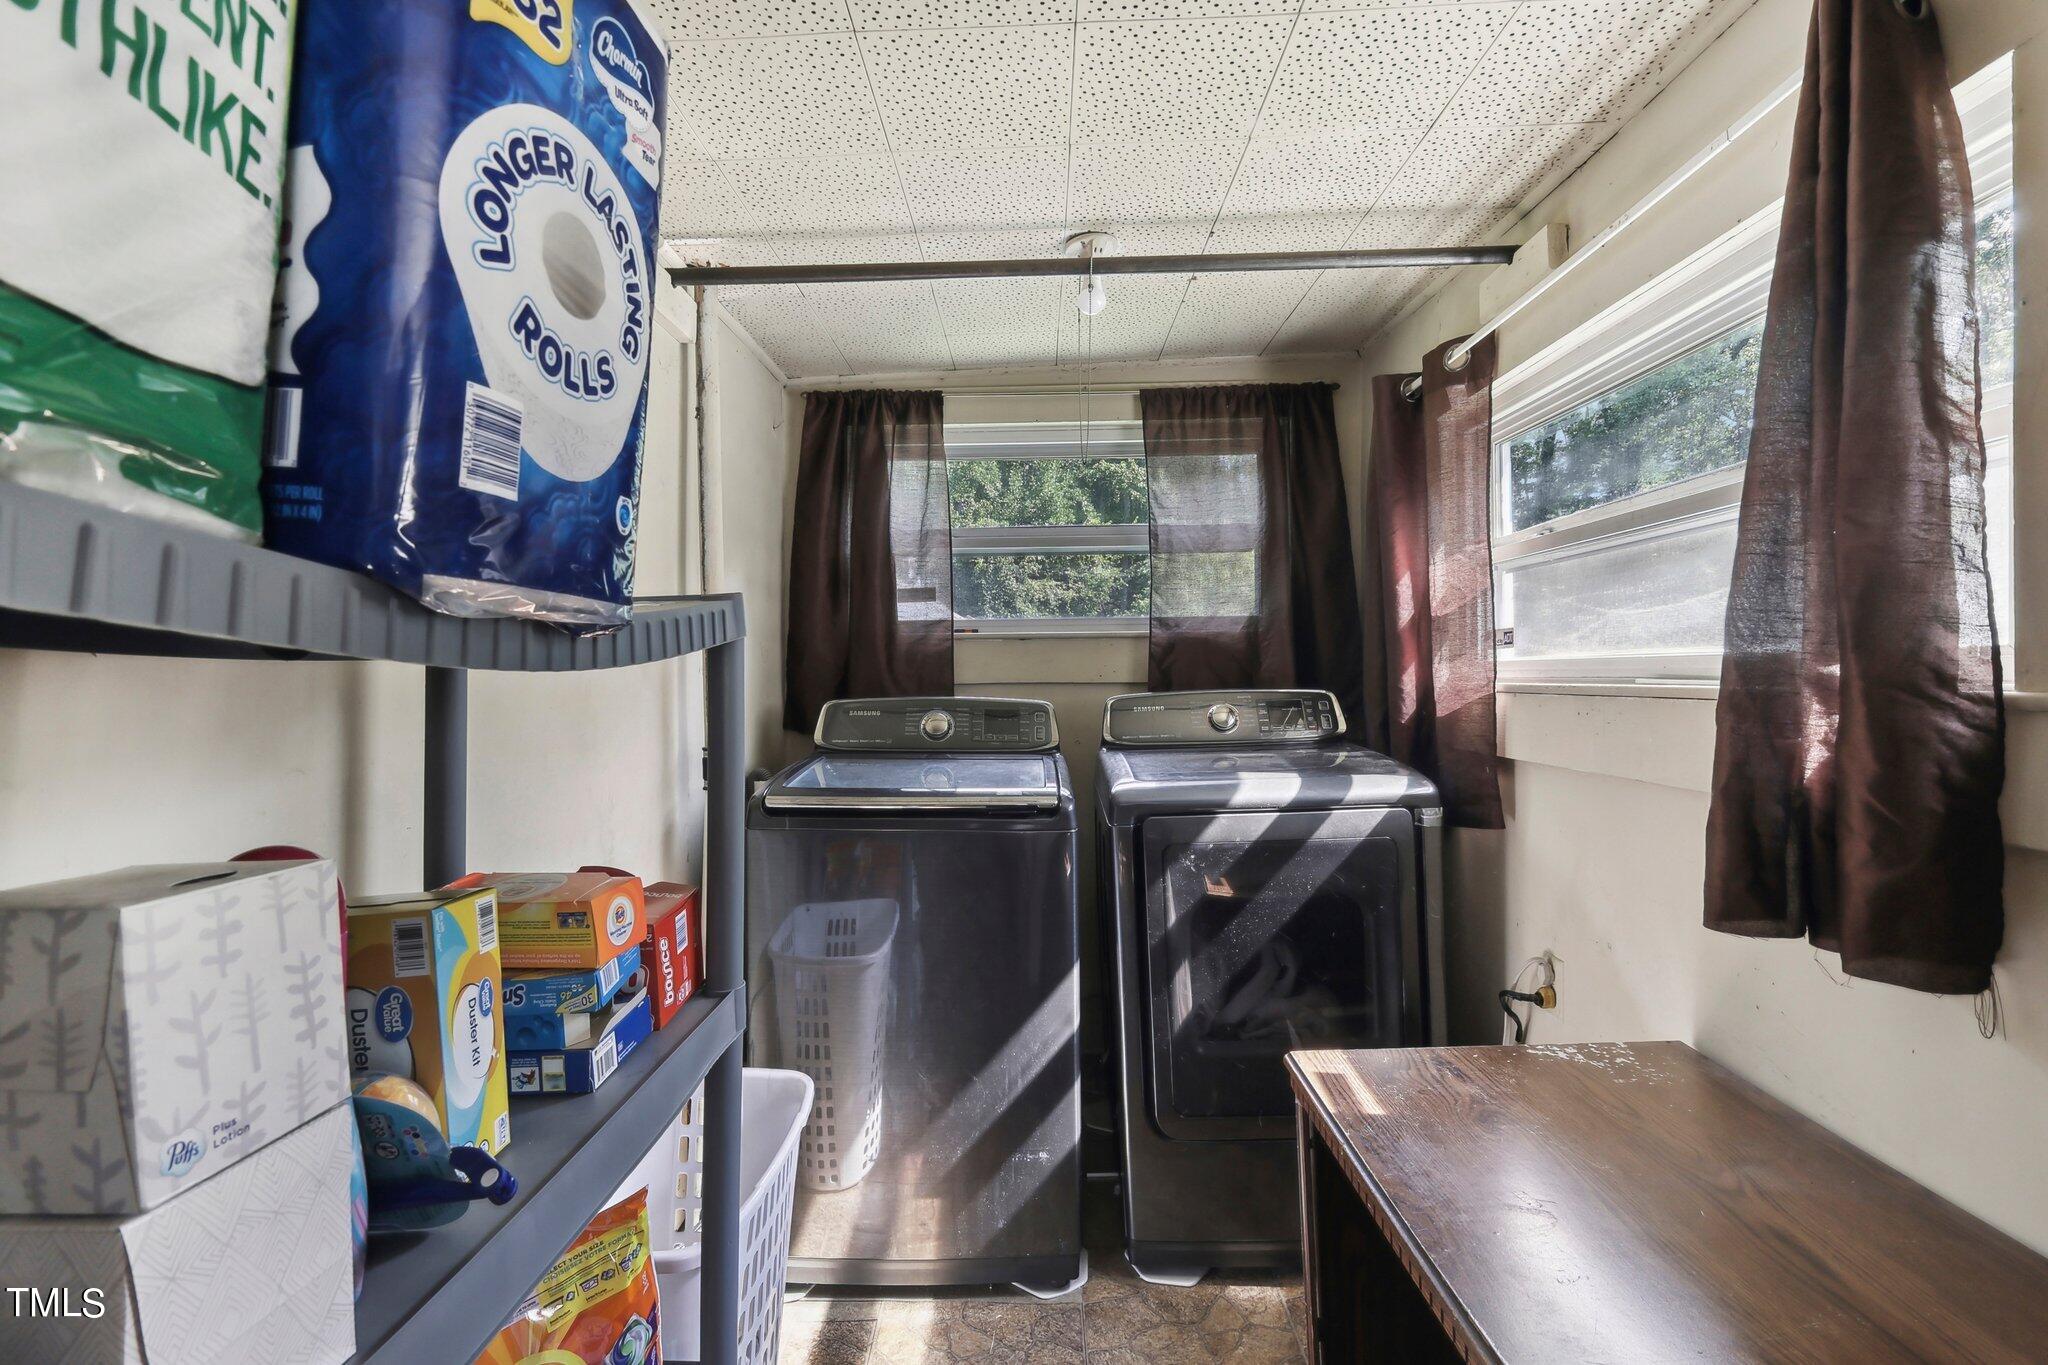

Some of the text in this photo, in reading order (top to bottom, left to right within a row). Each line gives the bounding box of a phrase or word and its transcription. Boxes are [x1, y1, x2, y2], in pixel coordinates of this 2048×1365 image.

[597, 30, 643, 89] Charmin
[614, 85, 649, 121] Ultra Soft
[631, 133, 656, 156] Smooth
[641, 150, 656, 166] Tear
[474, 135, 644, 360] LONGER LASTING
[513, 303, 616, 396] ROLLS
[659, 937, 675, 1009] bounce
[389, 992, 404, 1032] Great
[581, 993, 594, 1007] 30
[382, 1003, 392, 1033] Value
[467, 997, 481, 1067] Duster Kit
[351, 1008, 369, 1071] Duster
[213, 1117, 237, 1135] Plus
[213, 1124, 250, 1148] Lotion
[167, 1141, 200, 1171] Puffs
[547, 1240, 604, 1275] LECT YOUR SIZE
